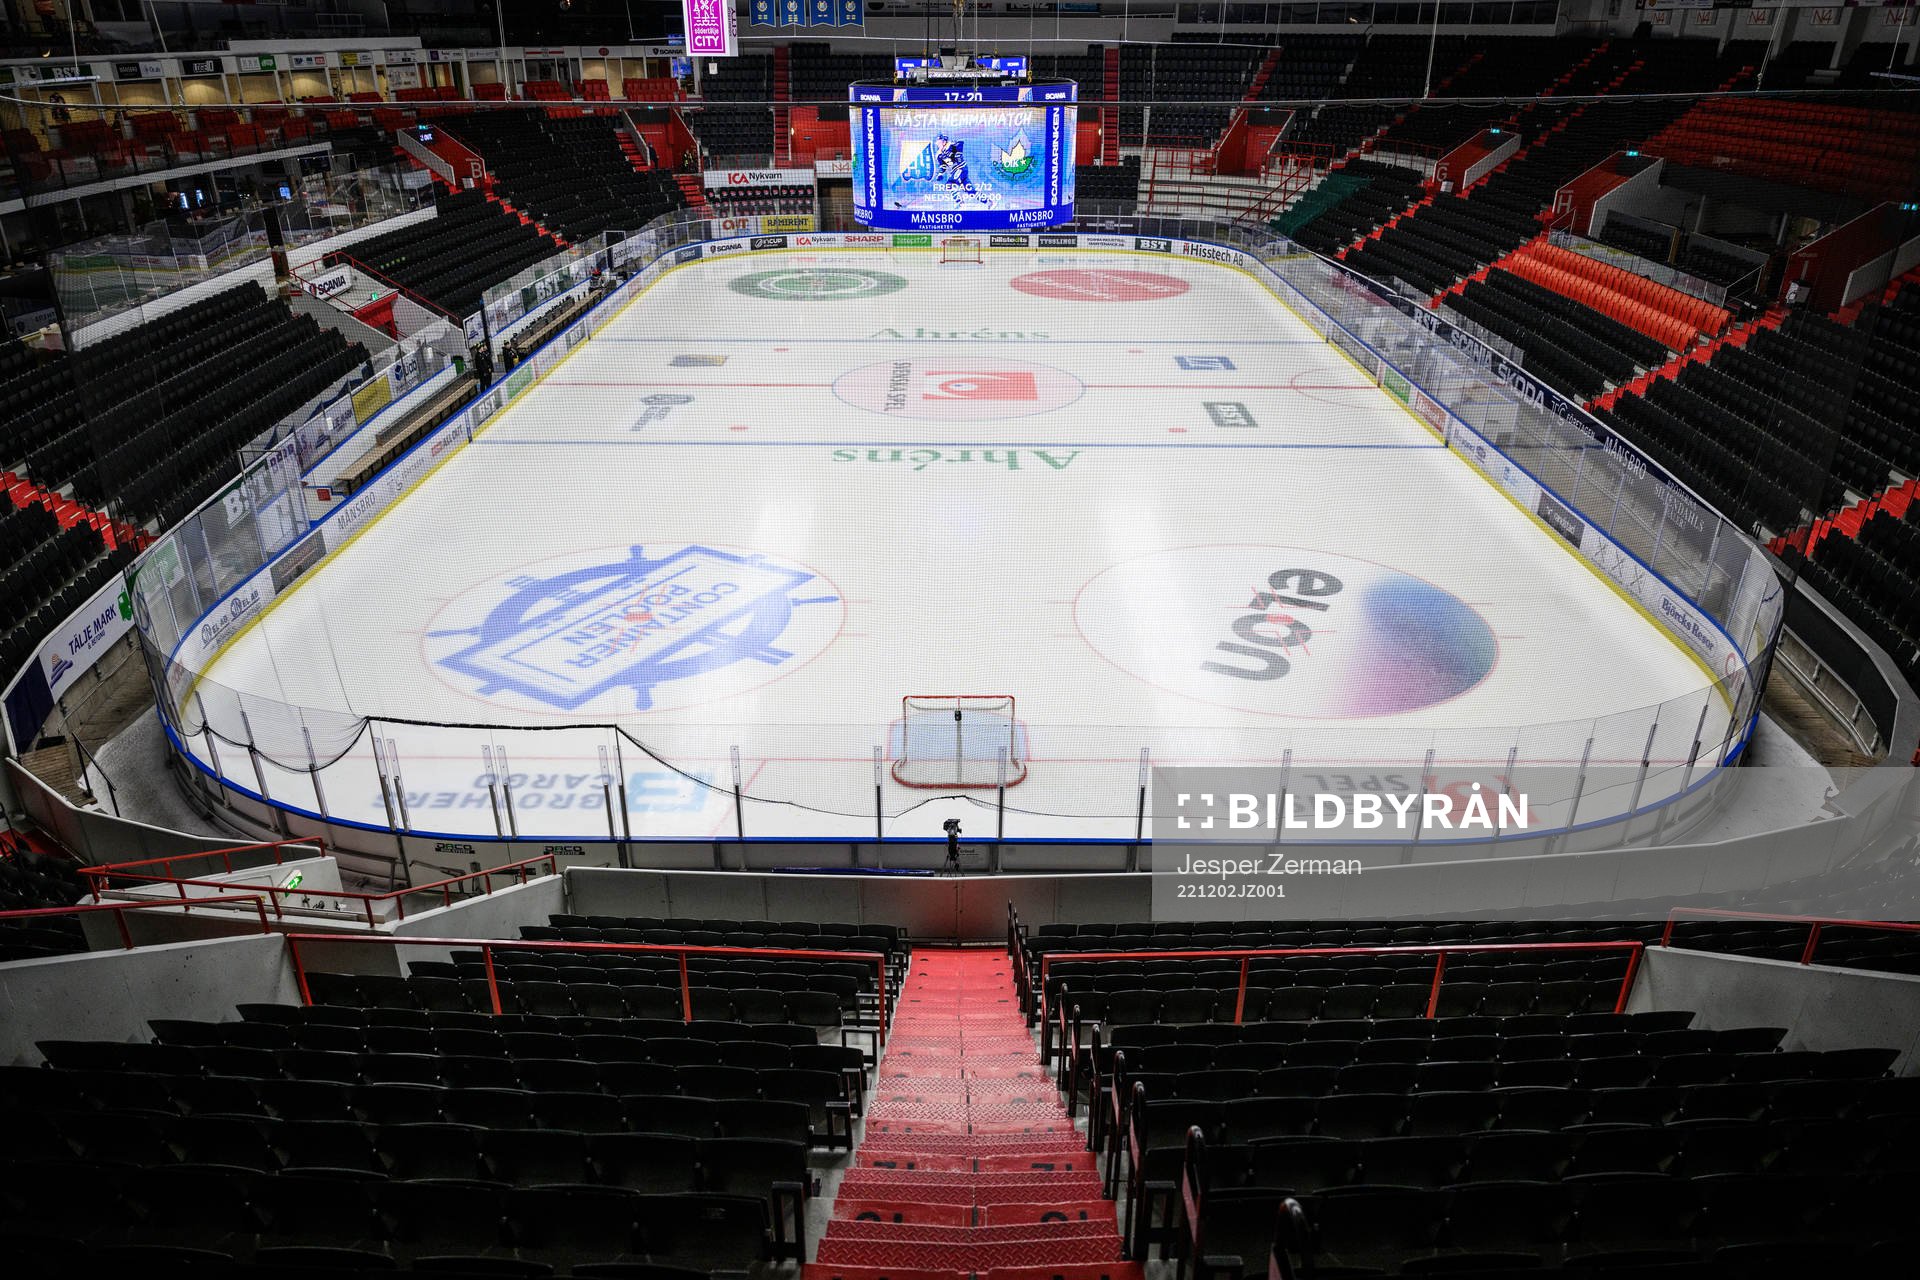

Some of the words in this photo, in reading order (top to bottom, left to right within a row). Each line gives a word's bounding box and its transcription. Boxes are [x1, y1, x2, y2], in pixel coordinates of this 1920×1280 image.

[695, 35, 720, 47] CITY
[1045, 92, 1066, 100] SCANIA
[894, 111, 936, 127] NÄSTA
[941, 110, 1033, 128] HEMMAMATCH
[865, 108, 877, 208] SCANIARINKEN
[1050, 107, 1061, 206] SCANIARINKEN
[470, 162, 482, 179] B
[727, 172, 749, 185] ICA
[749, 172, 783, 182] Nykvarn
[1436, 166, 1448, 182] G
[932, 183, 973, 192] FREDAG
[1557, 194, 1573, 214] H
[767, 217, 809, 227] RAMIRENT
[911, 210, 963, 224] MÅNSBRO
[1009, 209, 1054, 223] MÅNSBRO
[717, 243, 743, 252] SCANIA
[796, 237, 812, 246] ICA
[812, 236, 836, 244] Nykvarn
[844, 235, 885, 243] SHARP
[1139, 239, 1167, 251] BST
[1190, 243, 1231, 263] Hisstech
[1232, 253, 1245, 267] AB
[317, 274, 347, 296] SCANIA
[1415, 306, 1441, 333] BST
[869, 326, 1051, 342] Ahréns
[1450, 326, 1494, 371] SCANIA
[1499, 361, 1546, 416] ŠKODA
[1566, 412, 1596, 441] FÖRETAGEN
[832, 447, 1084, 472] Ahréns
[1603, 434, 1648, 480] MÅNSBRO
[337, 491, 376, 531] MÅNSBRO
[561, 584, 695, 646] POOLEN
[1661, 597, 1692, 631] Björcks
[1691, 623, 1715, 651] Resor
[68, 624, 93, 655] TÄLJE
[93, 604, 117, 635] MARK
[563, 580, 740, 671] CONTAINER
[474, 773, 616, 790] CARGO
[1303, 774, 1411, 792] SPEL
[371, 792, 608, 810] BROTHERS
